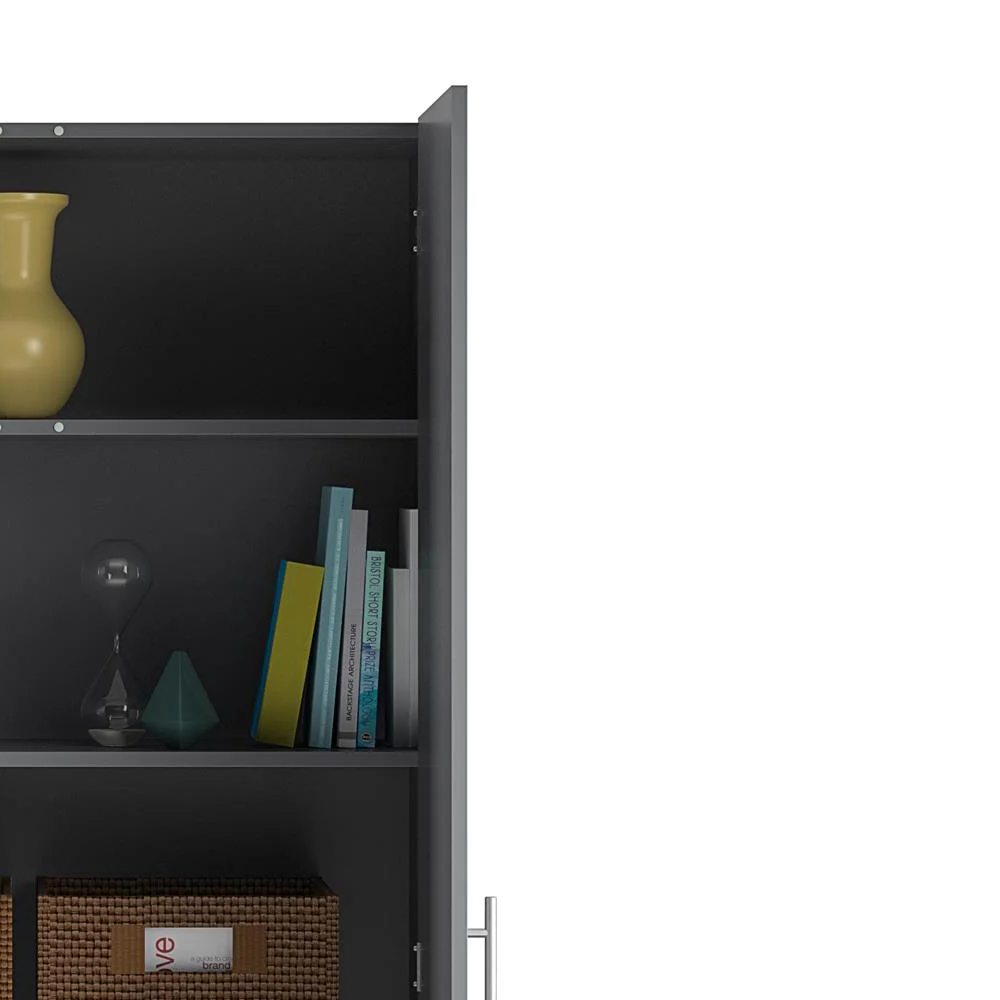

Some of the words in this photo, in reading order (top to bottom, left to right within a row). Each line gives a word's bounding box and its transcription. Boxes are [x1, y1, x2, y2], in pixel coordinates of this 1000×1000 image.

[370, 556, 382, 588] BRISTOL
[367, 591, 379, 618] SHORT
[348, 623, 357, 677] ARCHITECTURE
[364, 651, 376, 673] PRIZE
[346, 680, 354, 722] BACKSTAGE
[155, 936, 175, 972] ve
[202, 961, 231, 970] brand
